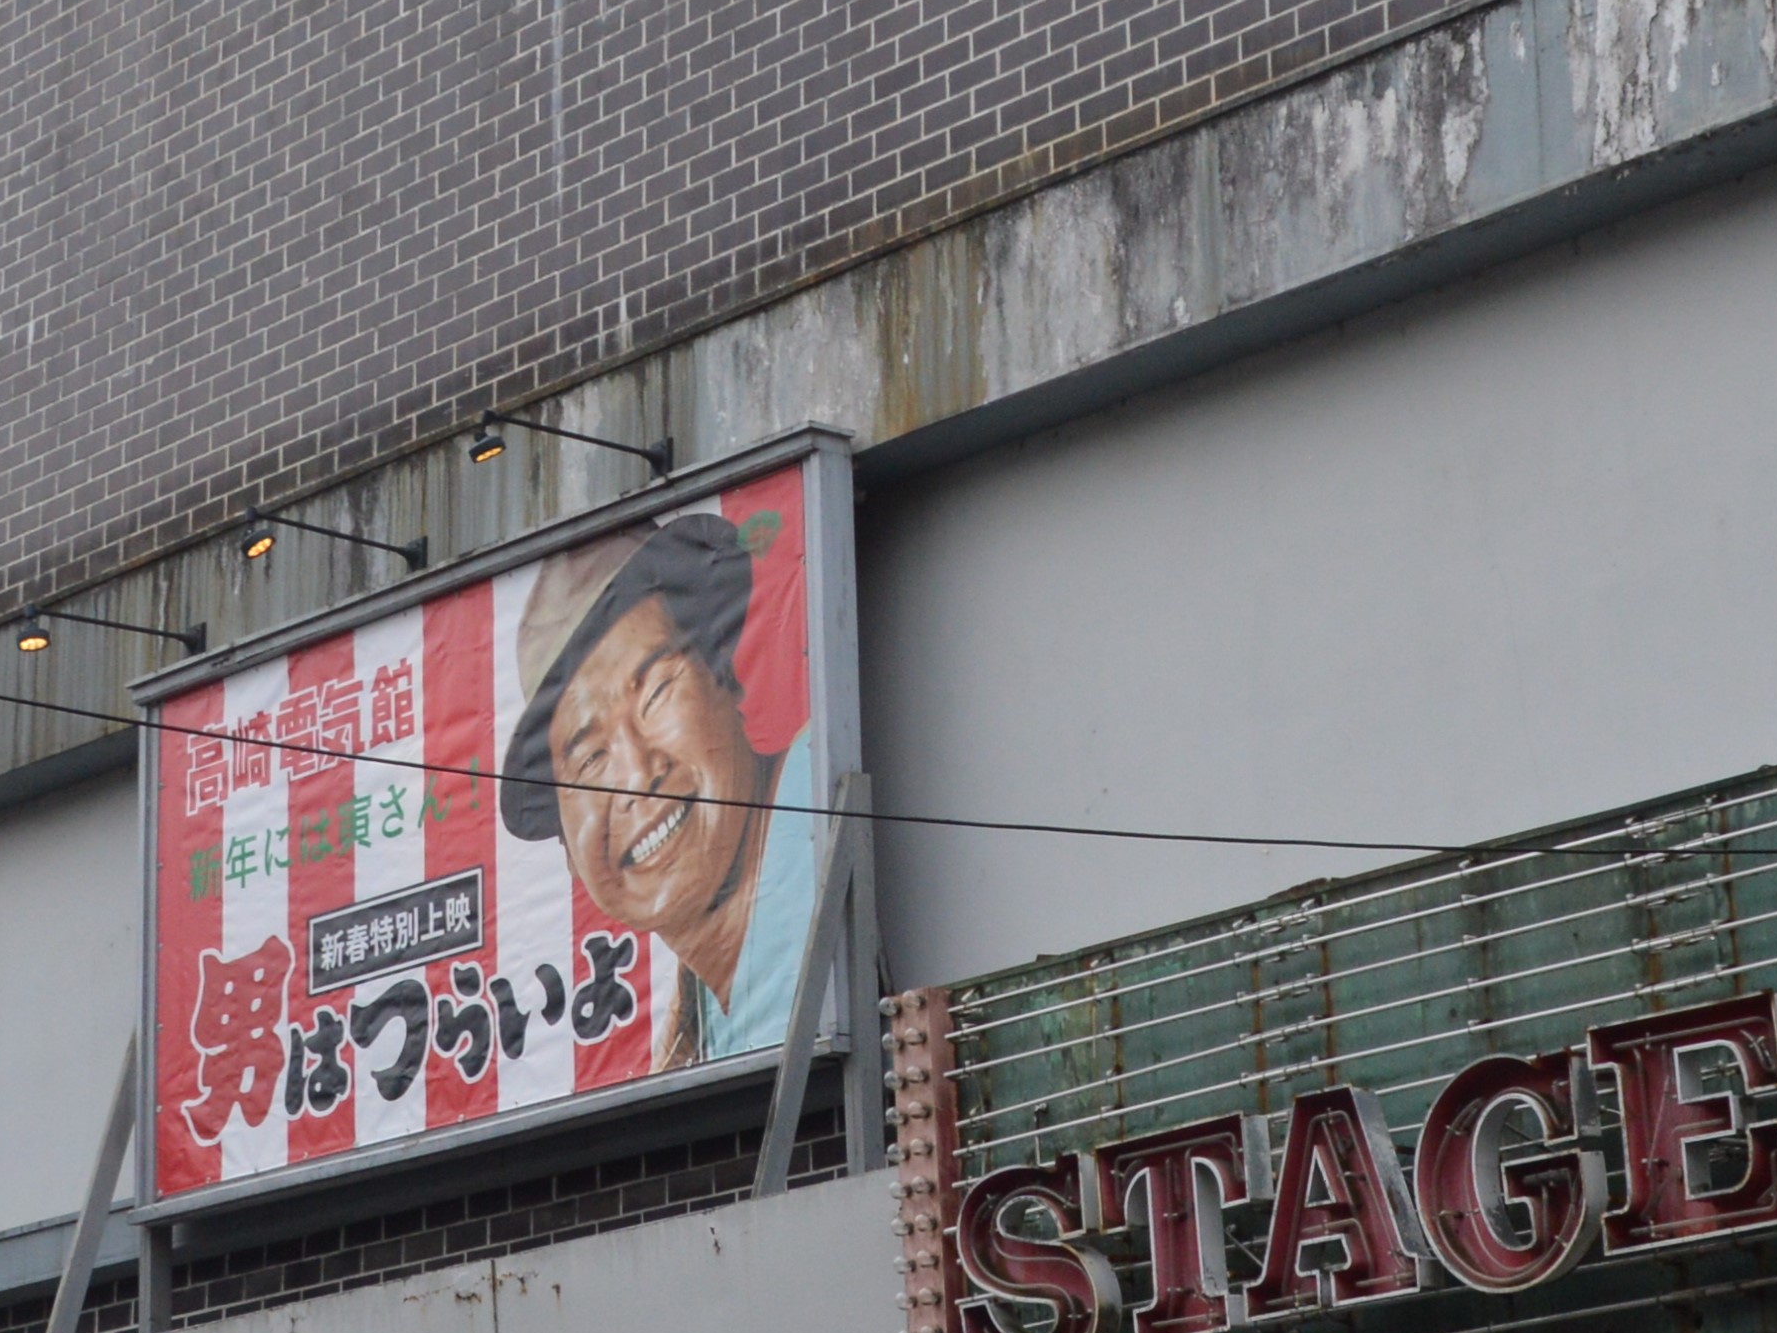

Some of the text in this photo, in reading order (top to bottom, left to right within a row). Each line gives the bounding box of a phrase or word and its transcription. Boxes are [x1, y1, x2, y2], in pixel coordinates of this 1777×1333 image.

[186, 657, 415, 817] 高崎電気館
[189, 756, 480, 902] 新年には寅さん！
[319, 892, 473, 972] 新春特別上映
[180, 929, 637, 1147] 男はつらいよ
